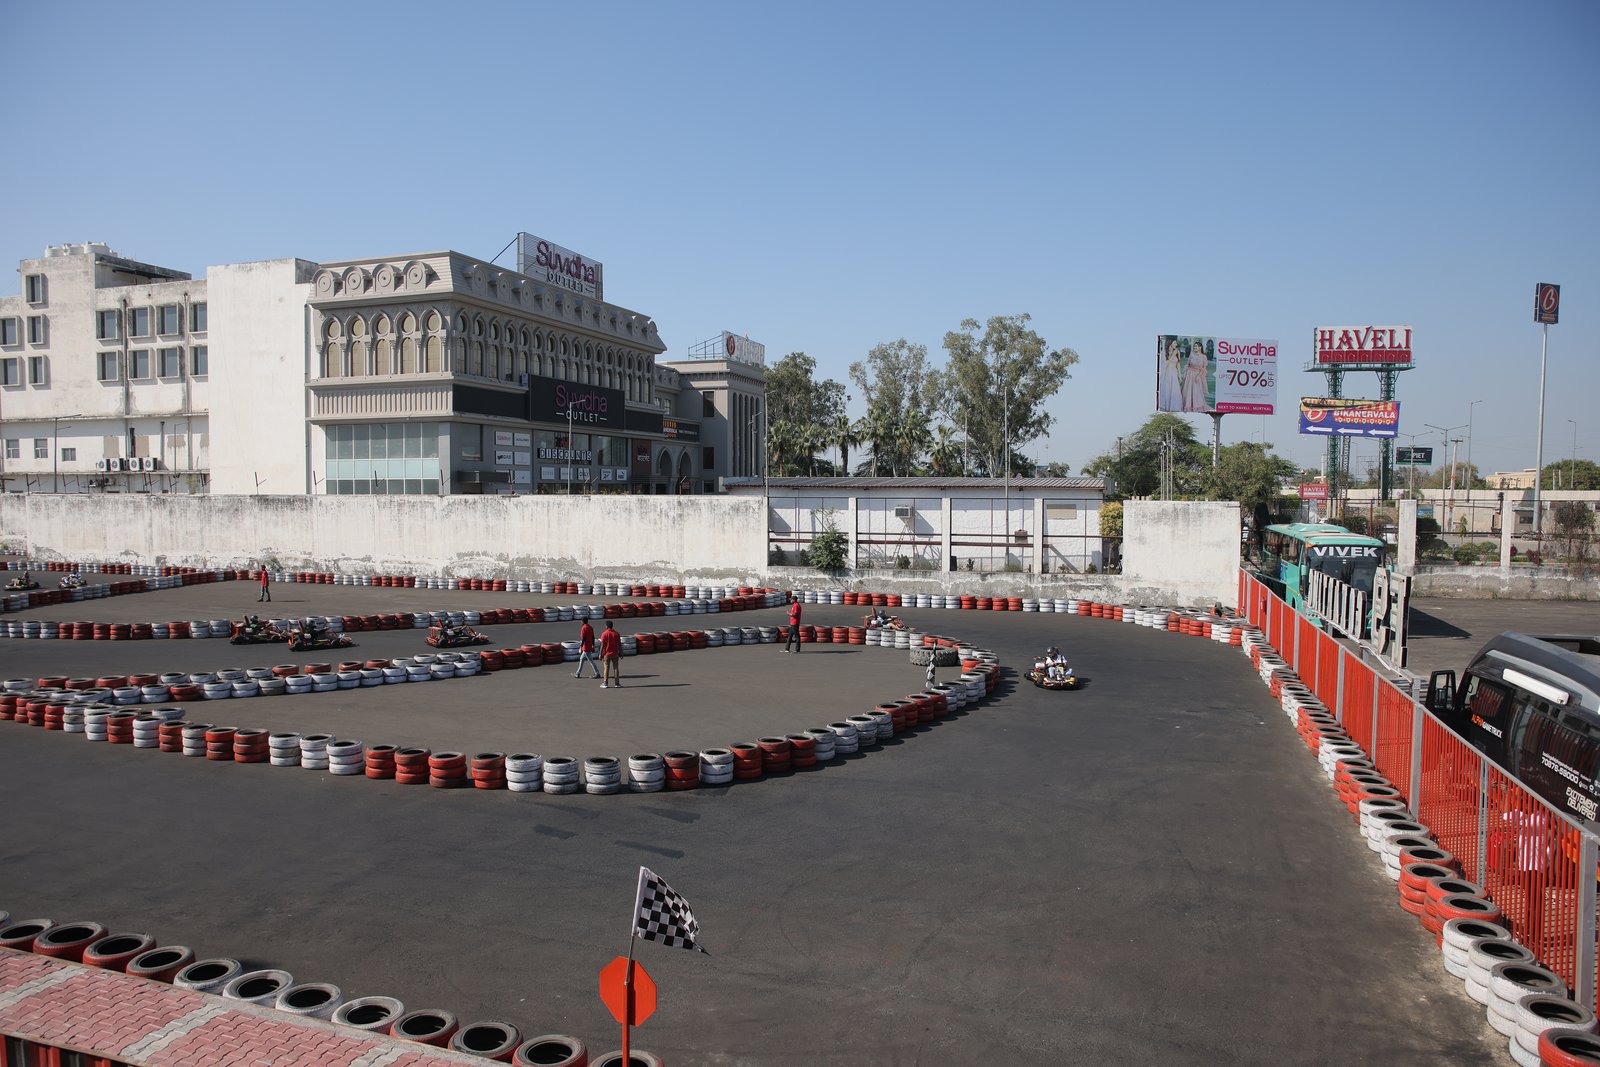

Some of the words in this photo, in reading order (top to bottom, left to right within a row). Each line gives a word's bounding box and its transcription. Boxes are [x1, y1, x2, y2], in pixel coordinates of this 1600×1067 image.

[537, 240, 595, 285] Suvidha
[547, 272, 584, 293] OUTLET
[1318, 325, 1412, 350] HAVELI
[1218, 341, 1276, 357] Suvidha
[1229, 357, 1264, 365] OUTLET
[1227, 370, 1267, 387] 70%
[556, 385, 607, 413] Suvidha
[565, 411, 598, 422] OUTLET
[1334, 410, 1396, 419] BIKANERVALA
[540, 449, 591, 461] DISCOUNTS
[1313, 546, 1378, 558] VIVEK
[1566, 787, 1598, 812] EXCITEMENT
[1567, 797, 1596, 821] DELIVERED
